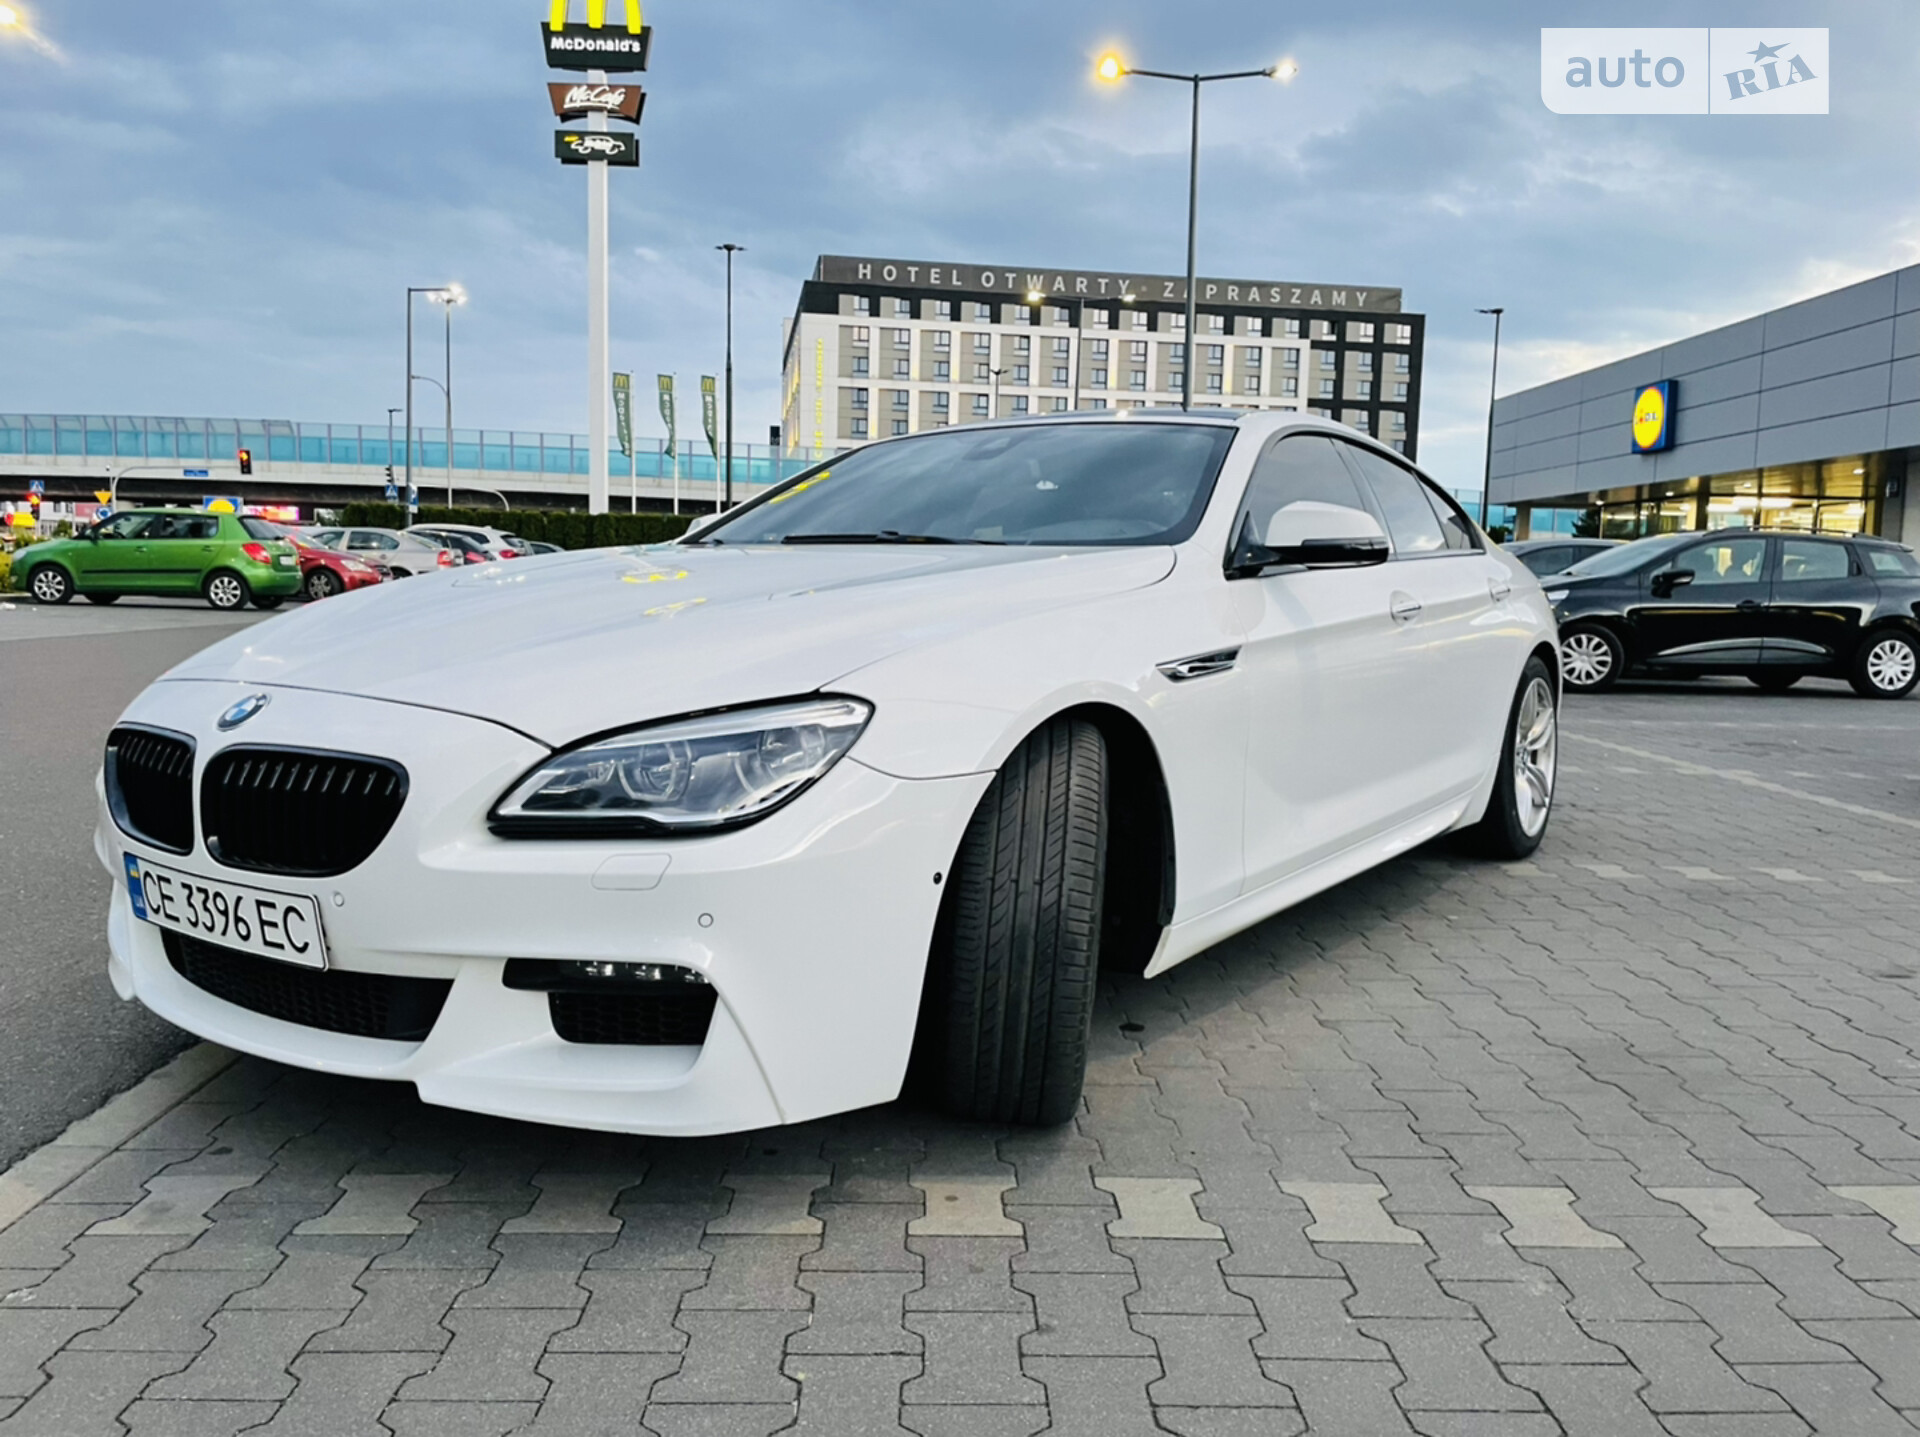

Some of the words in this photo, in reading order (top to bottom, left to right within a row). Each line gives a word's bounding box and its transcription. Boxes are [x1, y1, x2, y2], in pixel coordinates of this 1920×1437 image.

[551, 37, 641, 52] McDonald's
[858, 263, 962, 286] HOTEL
[980, 271, 1131, 294] OTWARTY
[1163, 282, 1368, 306] ZPRASZAMY
[143, 870, 180, 924] CE
[180, 882, 251, 942] 3396
[255, 899, 310, 954] EC
